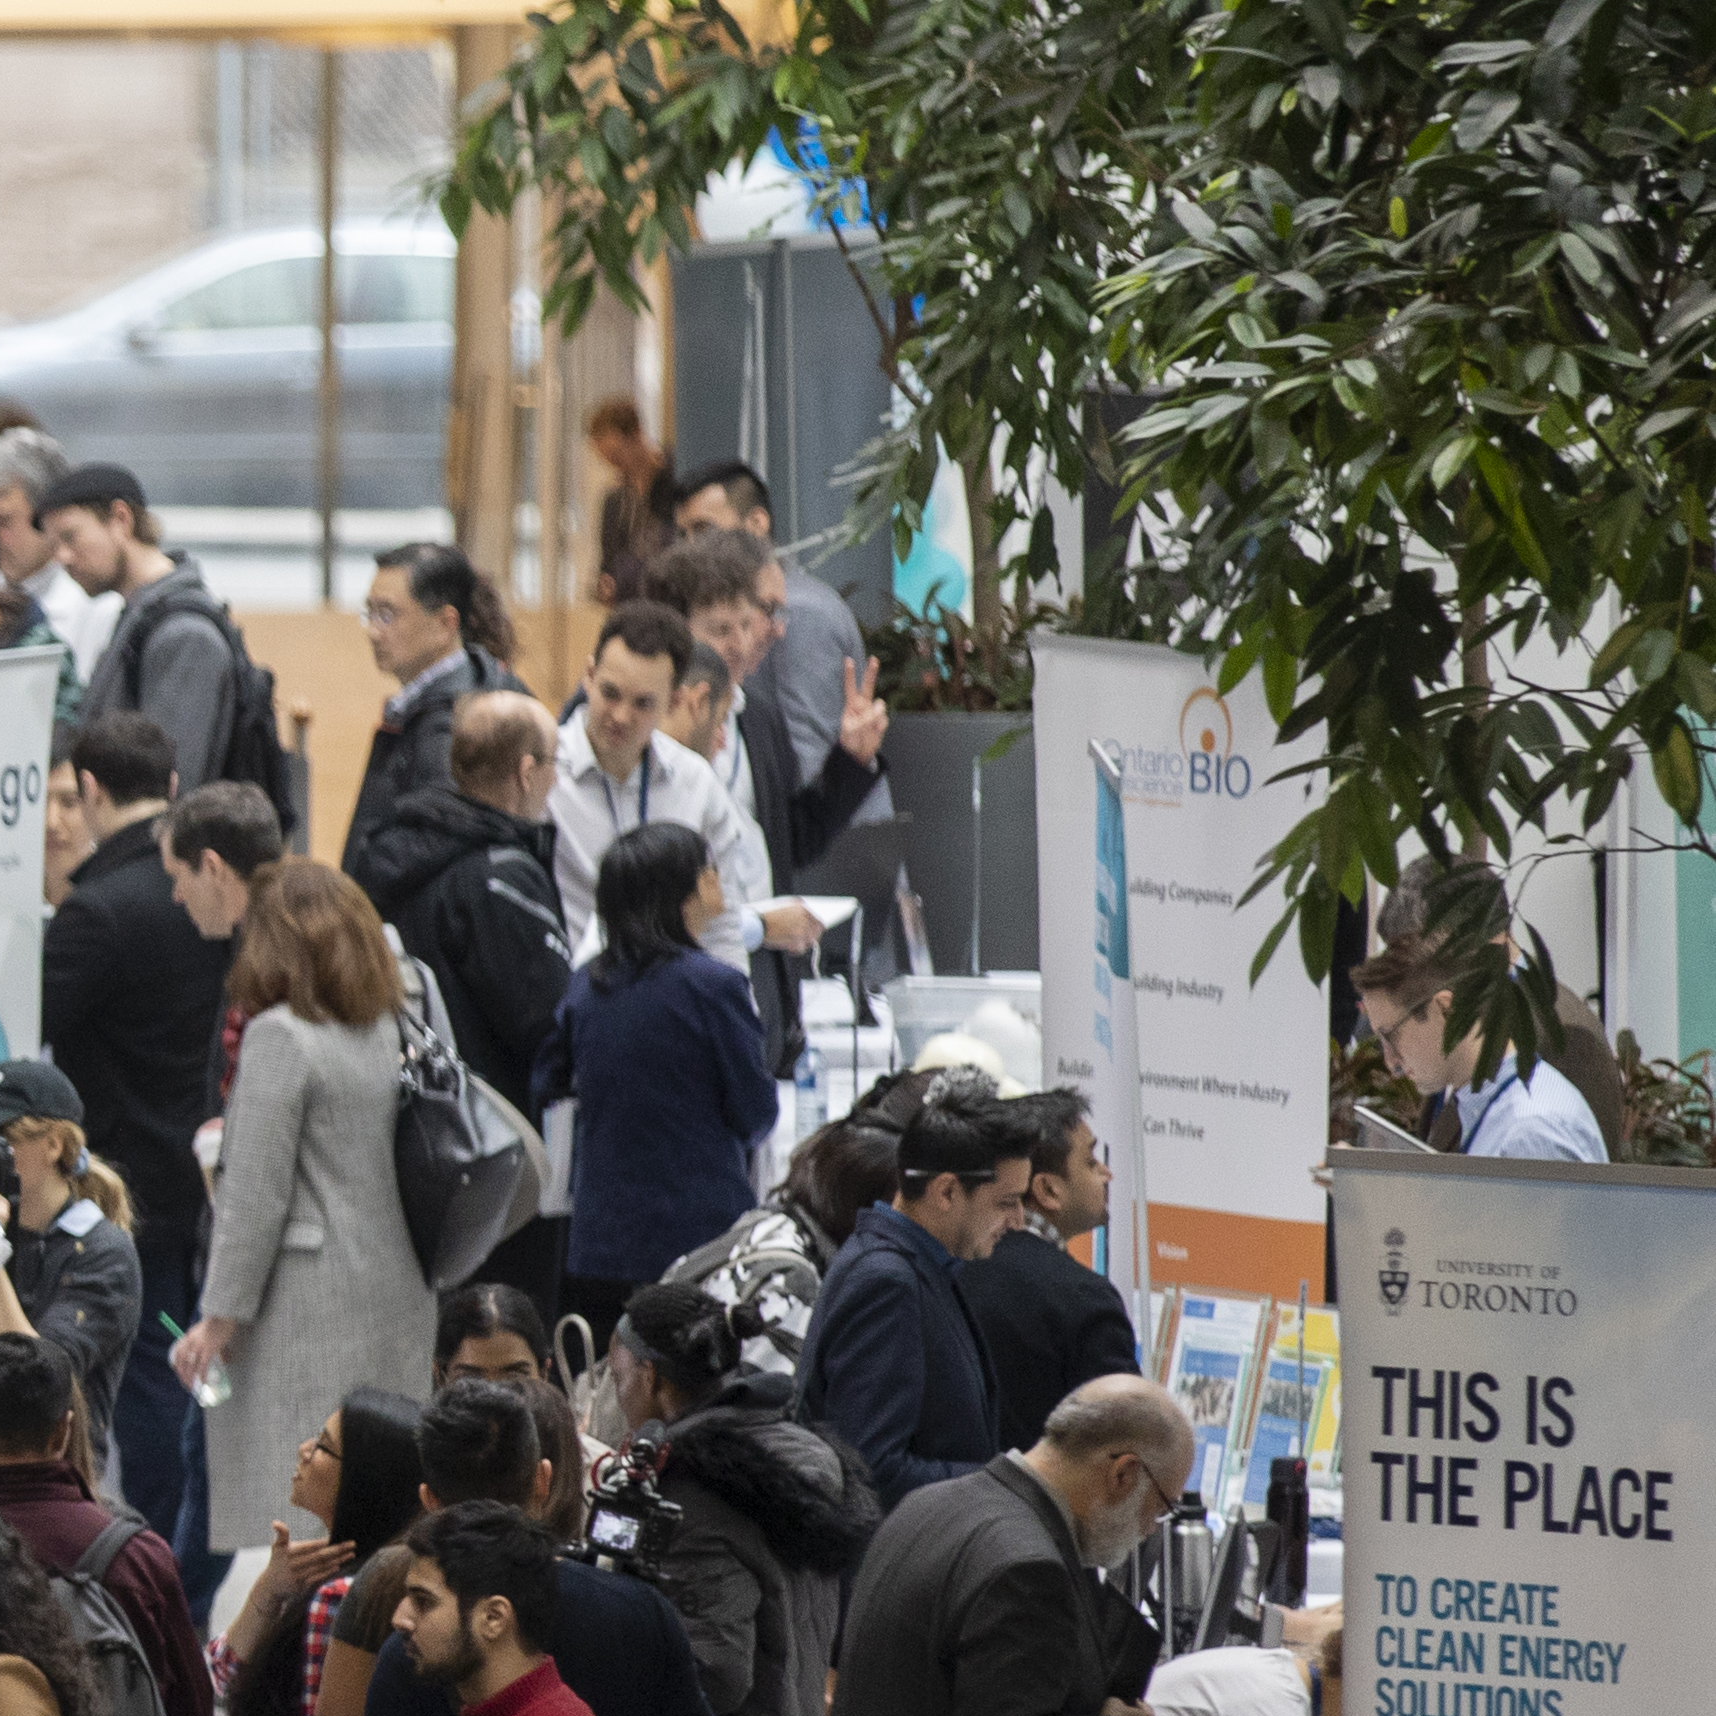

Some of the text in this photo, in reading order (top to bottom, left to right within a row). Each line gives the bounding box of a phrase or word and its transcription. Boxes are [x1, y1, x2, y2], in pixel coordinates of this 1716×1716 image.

[1190, 751, 1251, 800] BIO
[1169, 880, 1233, 906] Companies
[1133, 973, 1224, 1004] uilding Industry
[1057, 1056, 1289, 1109] Buildin vironment Where Industry
[1143, 1114, 1205, 1140] Can Thrive
[1436, 1259, 1561, 1280] UNIVERSITY OF
[1419, 1280, 1578, 1317] TORONTO
[1371, 1365, 1575, 1448] THIS IS
[1370, 1450, 1673, 1542] THE PLACE
[1375, 1573, 1560, 1627] TO CREATE
[1375, 1625, 1626, 1684] CLEAN ENERGY
